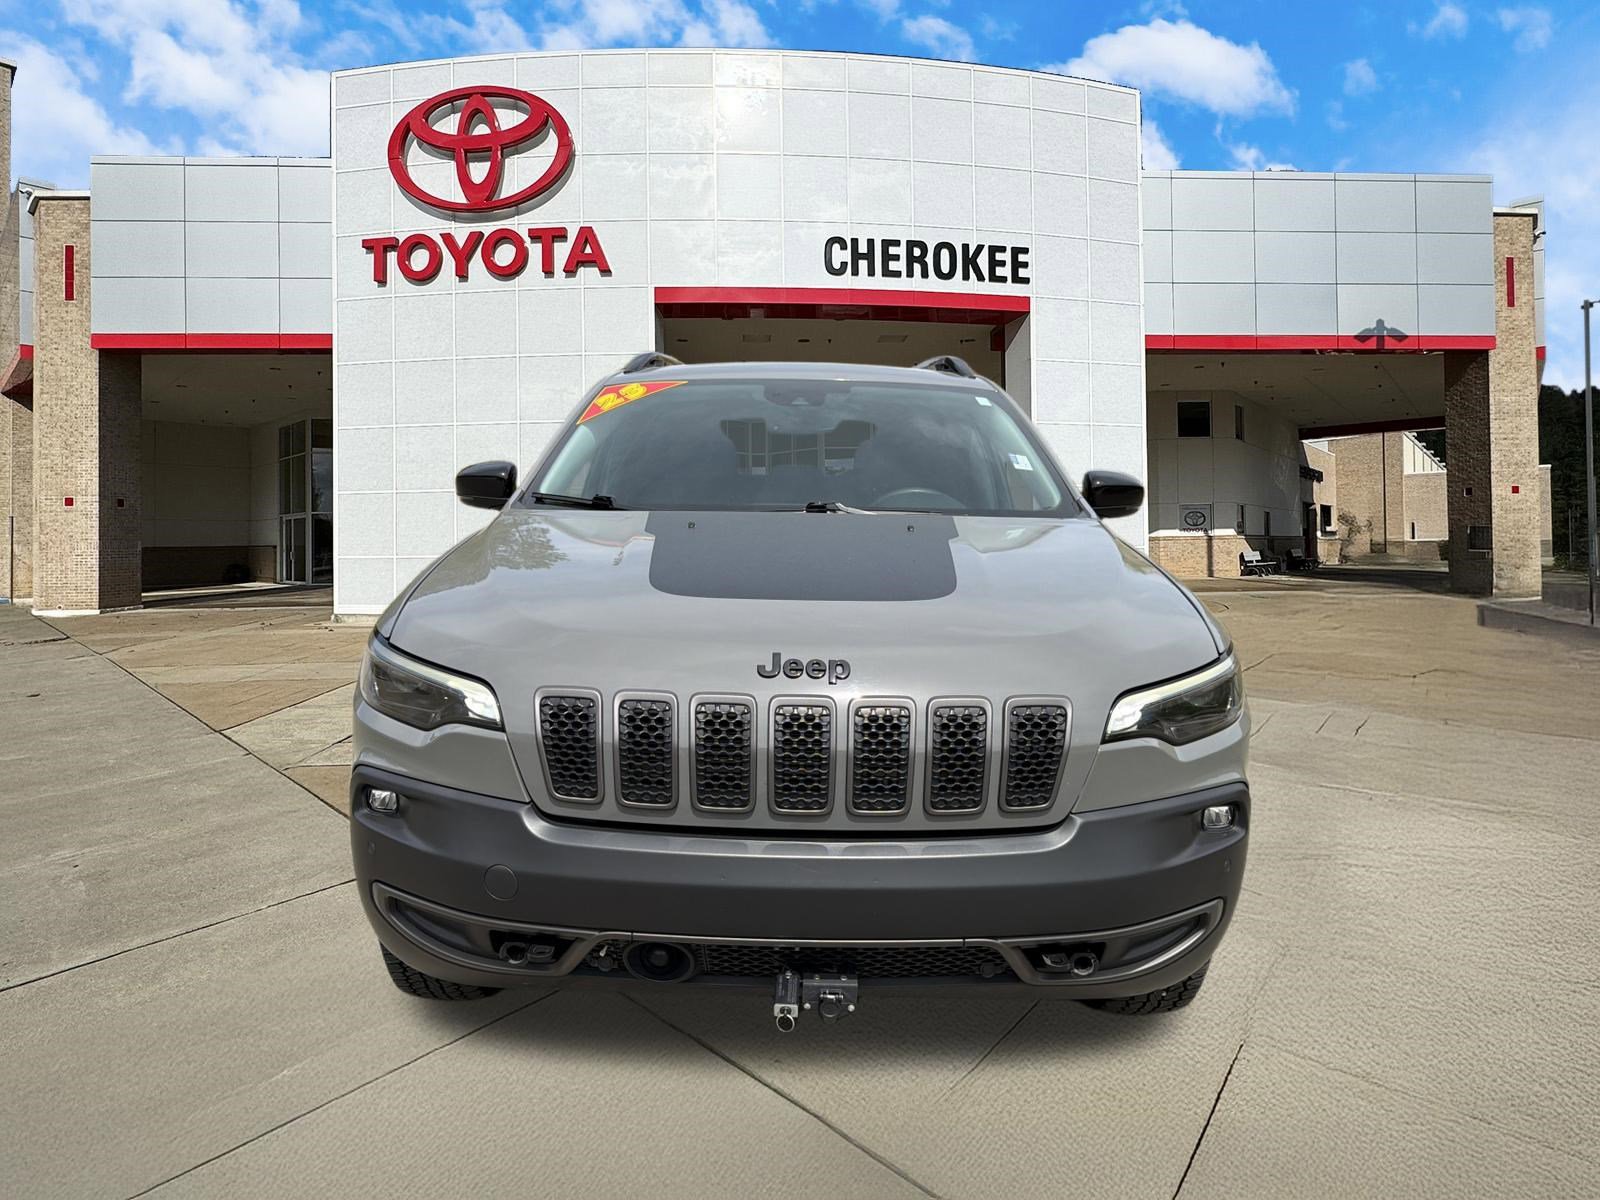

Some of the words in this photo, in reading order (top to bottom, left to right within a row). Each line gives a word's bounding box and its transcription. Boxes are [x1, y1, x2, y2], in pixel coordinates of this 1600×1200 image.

[362, 226, 611, 284] TOYOTA
[824, 236, 1031, 284] CHEROKEE
[757, 652, 851, 685] Jeep
